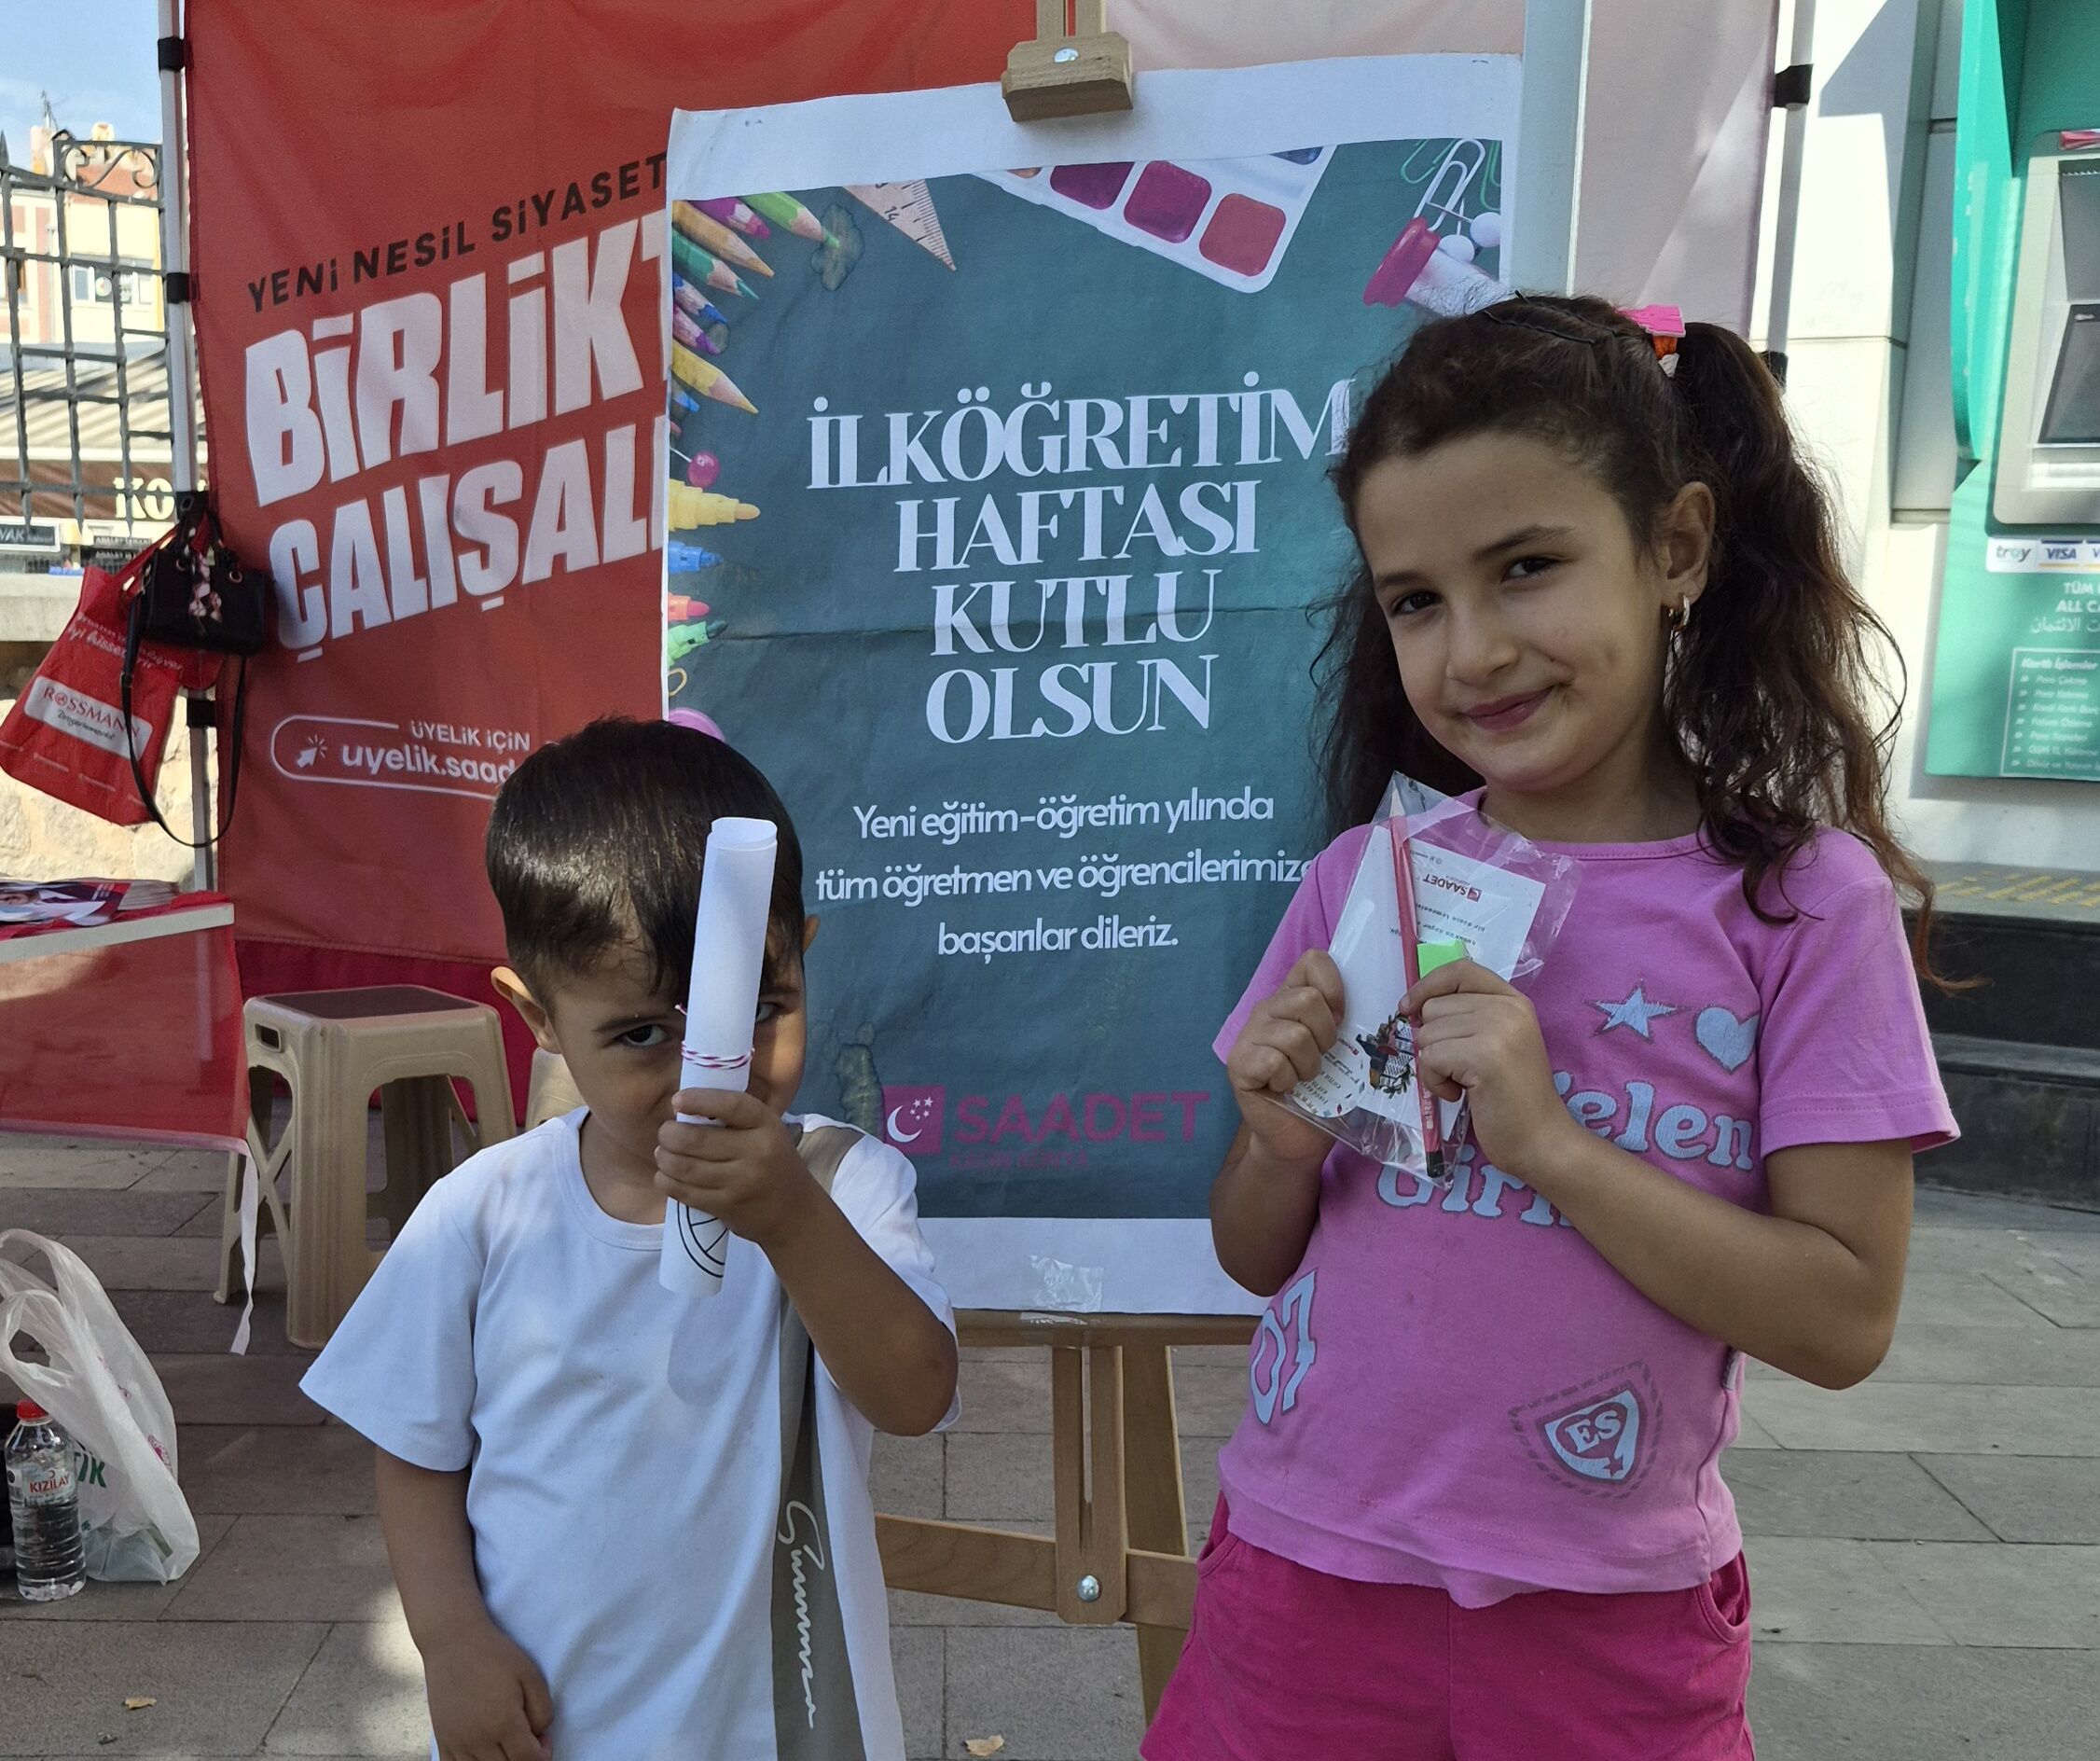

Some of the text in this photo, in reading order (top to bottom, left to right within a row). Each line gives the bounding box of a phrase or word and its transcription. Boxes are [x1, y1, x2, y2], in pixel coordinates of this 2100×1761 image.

[806, 371, 1357, 489] İLKÖĞRETİM
[893, 480, 1262, 573] HAFTASI
[1996, 545, 2032, 562] troy
[2046, 548, 2077, 560] VISA
[931, 569, 1223, 656] KUTLU
[2055, 600, 2083, 613] ALL
[925, 655, 1219, 743] OLSUN
[853, 804, 916, 839] Yeni
[1166, 786, 1274, 834] yılında
[816, 867, 877, 900] tüm
[883, 864, 1031, 907] öğretmen
[1037, 864, 1073, 891] ve
[1423, 873, 1468, 895] SAADET
[938, 915, 1180, 964] başarılar dileriz.
[954, 1090, 1210, 1145] SAADET
